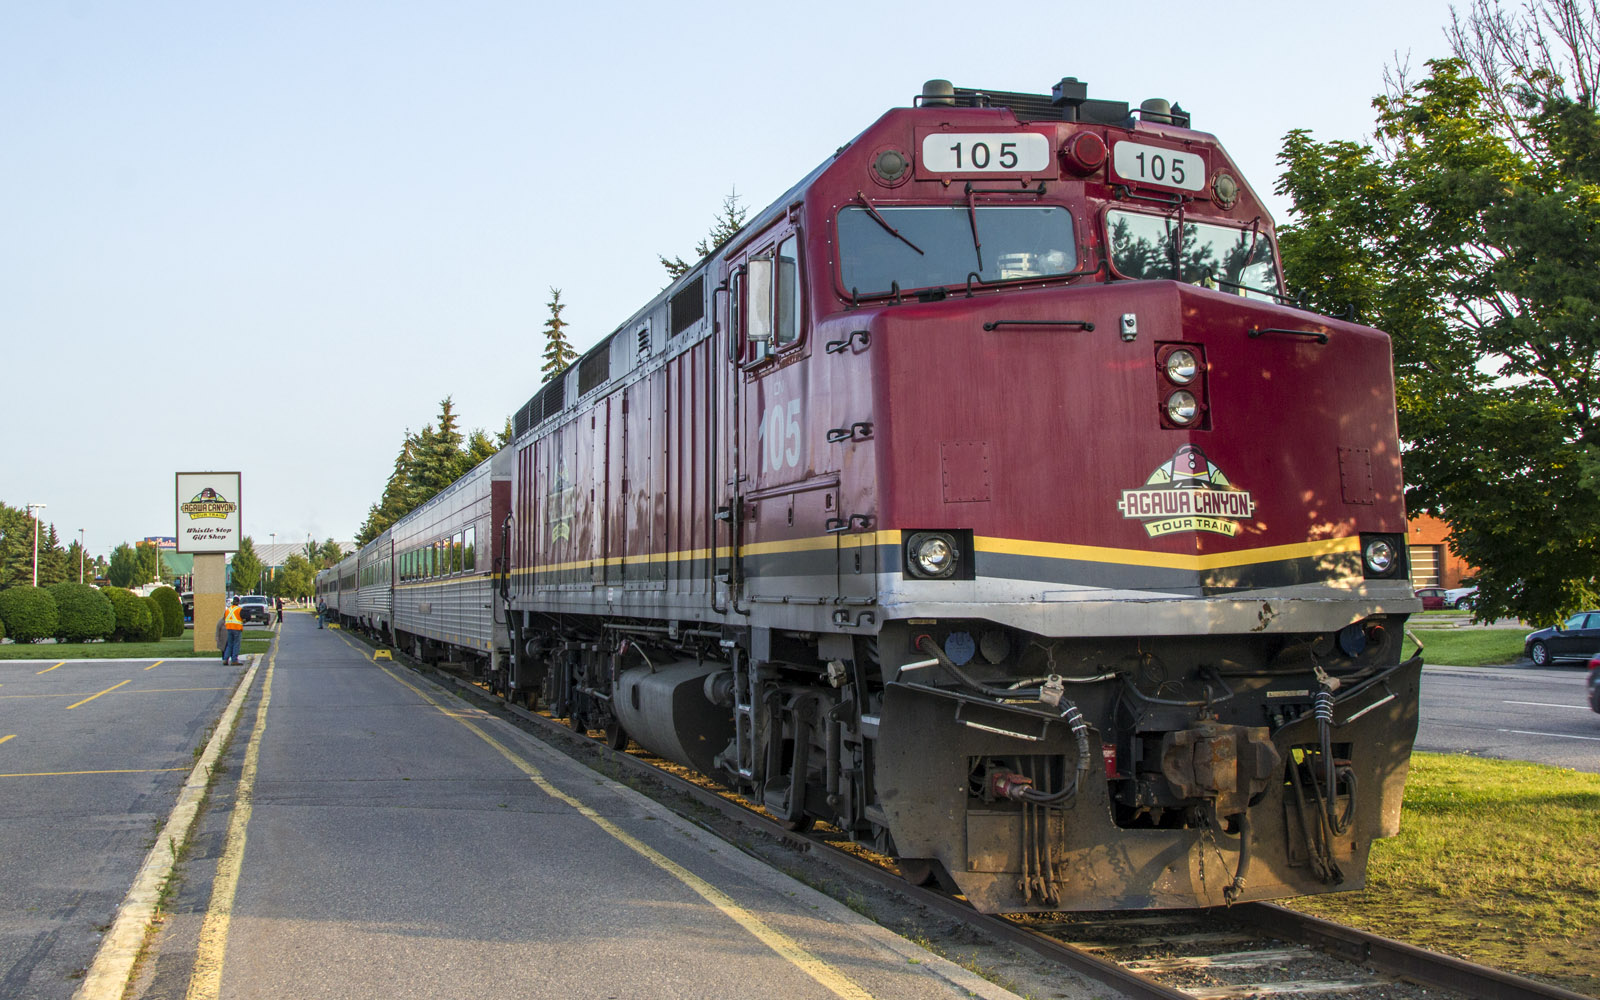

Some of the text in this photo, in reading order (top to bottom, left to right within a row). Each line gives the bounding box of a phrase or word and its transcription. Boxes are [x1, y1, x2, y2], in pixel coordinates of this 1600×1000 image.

[950, 142, 1018, 169] 105
[1135, 151, 1186, 184] 105
[758, 397, 801, 473] 105
[184, 503, 233, 512] AGAWA CANYON
[1126, 491, 1249, 515] AGAWA CANYON
[1152, 519, 1231, 533] TOUR TRAIN
